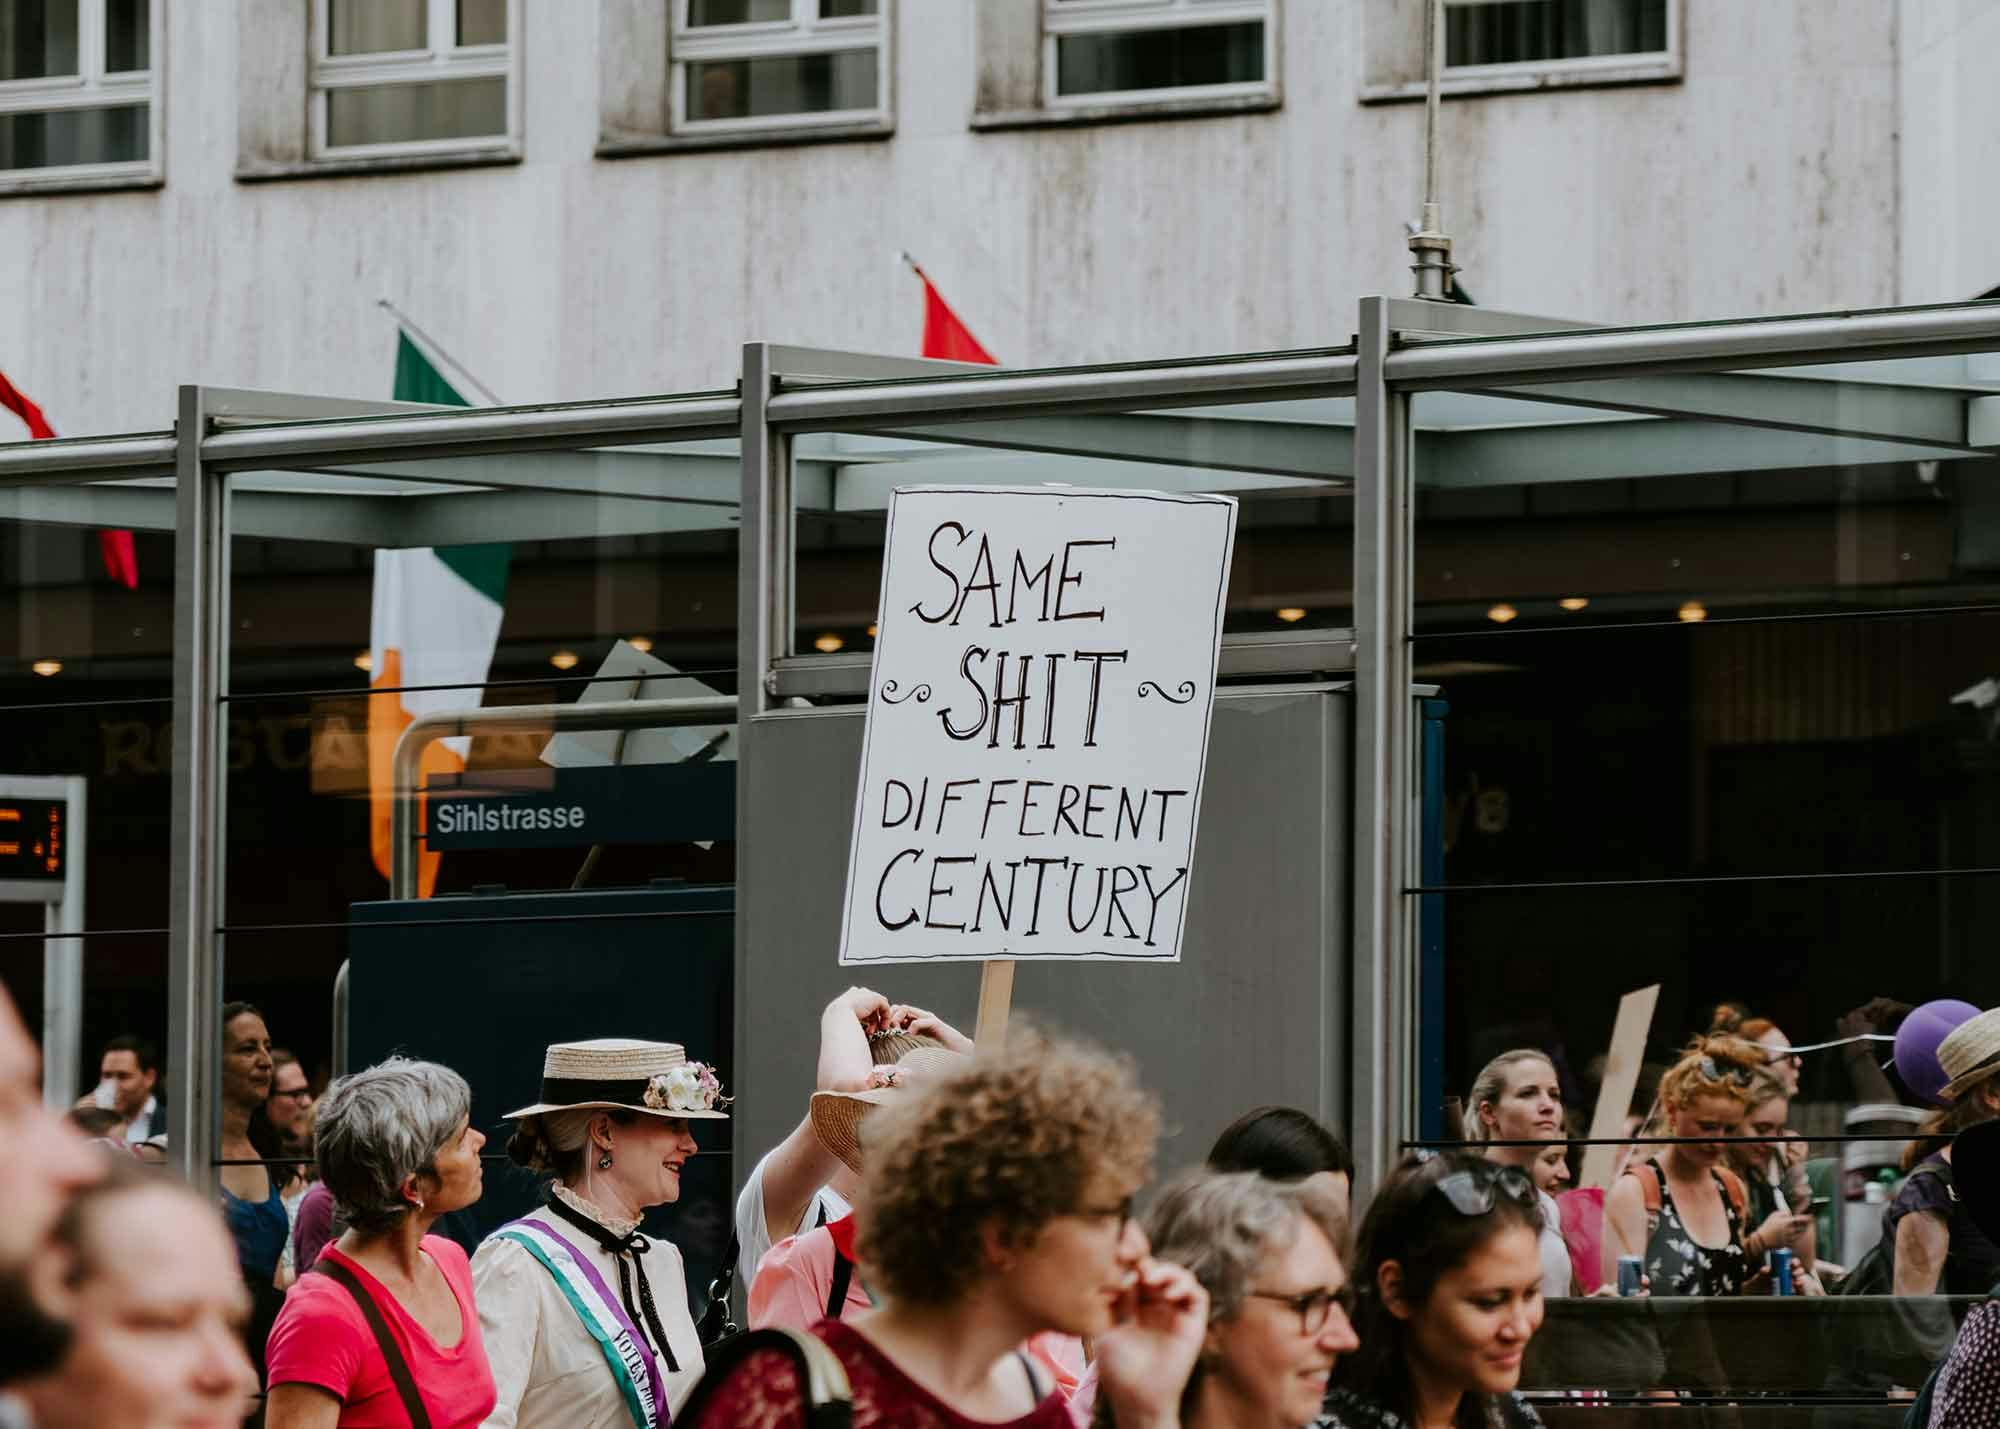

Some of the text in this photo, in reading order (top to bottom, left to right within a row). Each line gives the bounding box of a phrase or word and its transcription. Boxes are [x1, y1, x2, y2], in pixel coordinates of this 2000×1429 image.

[908, 521, 1116, 627] SAME
[936, 644, 1129, 750] SHIT
[436, 803, 585, 833] Sihlstrasse
[882, 777, 1188, 842] DIFFERENT
[875, 848, 1187, 946] CENTURY
[612, 1327, 647, 1386] VOTES
